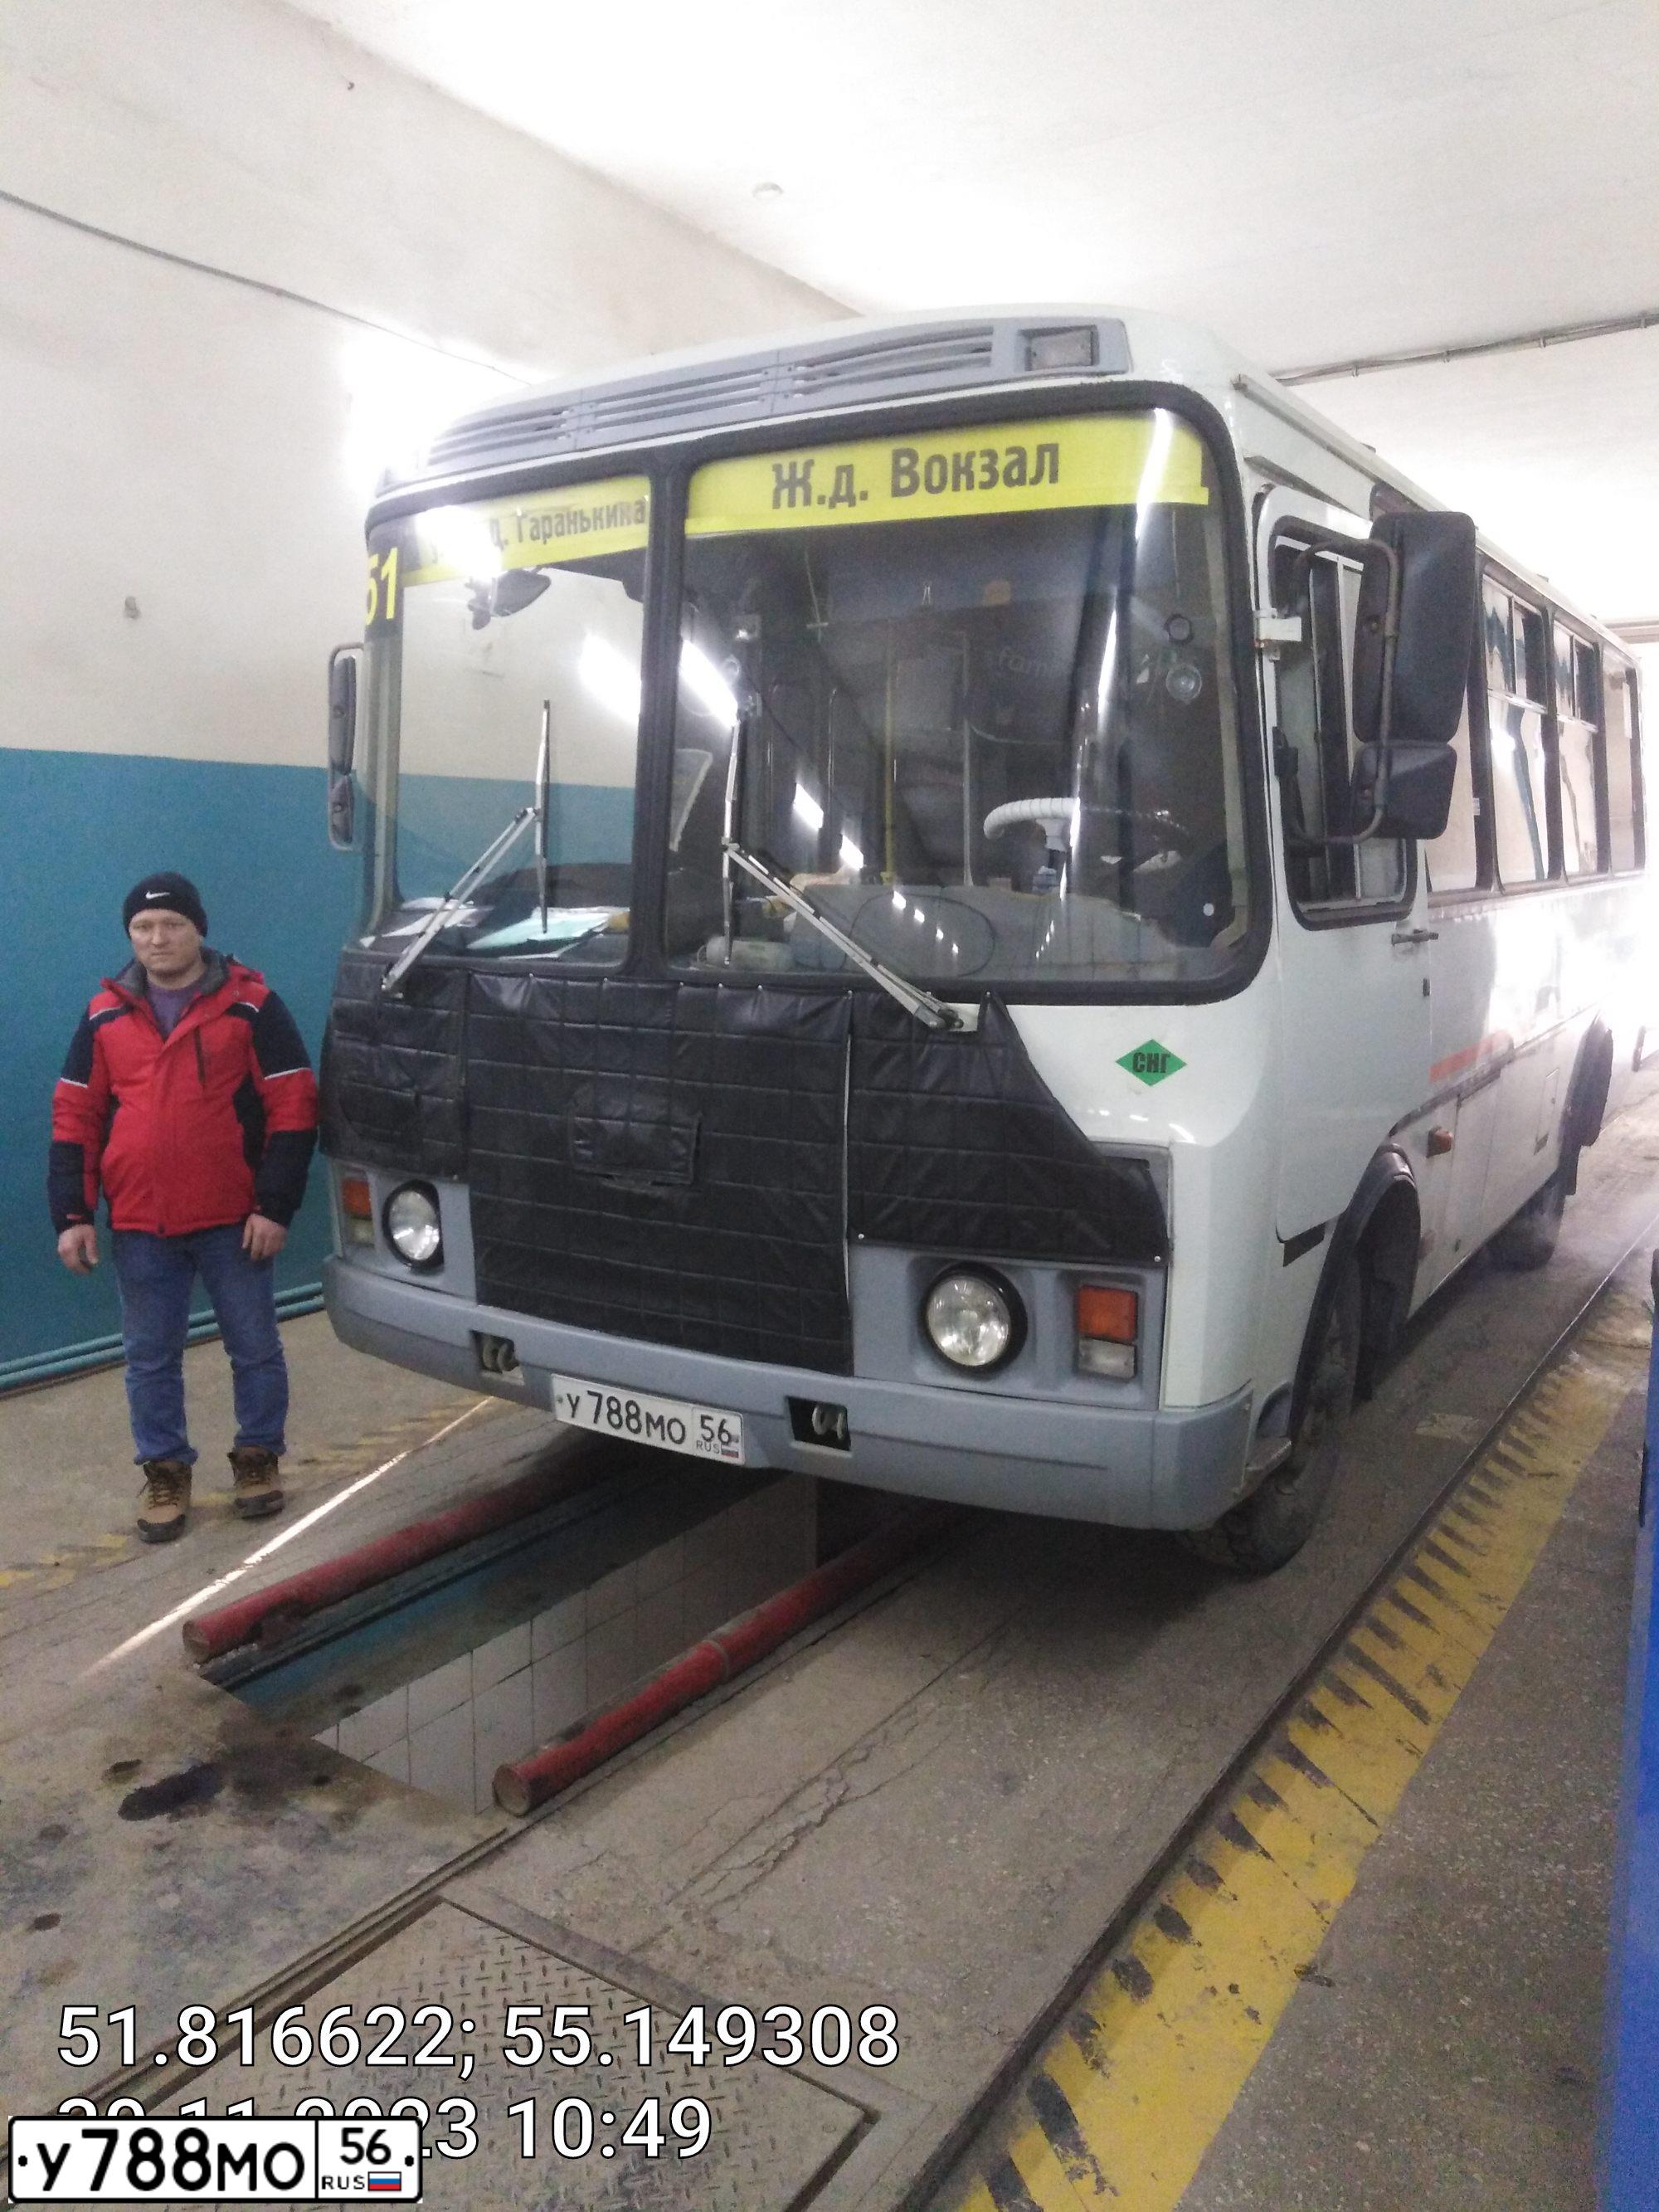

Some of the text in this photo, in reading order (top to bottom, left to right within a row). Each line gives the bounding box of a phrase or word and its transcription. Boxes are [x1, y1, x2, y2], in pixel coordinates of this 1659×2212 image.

[771, 441, 1059, 509] Ж.д. Вокзал
[700, 1414, 732, 1446] 56
[696, 1440, 720, 1454] RUS
